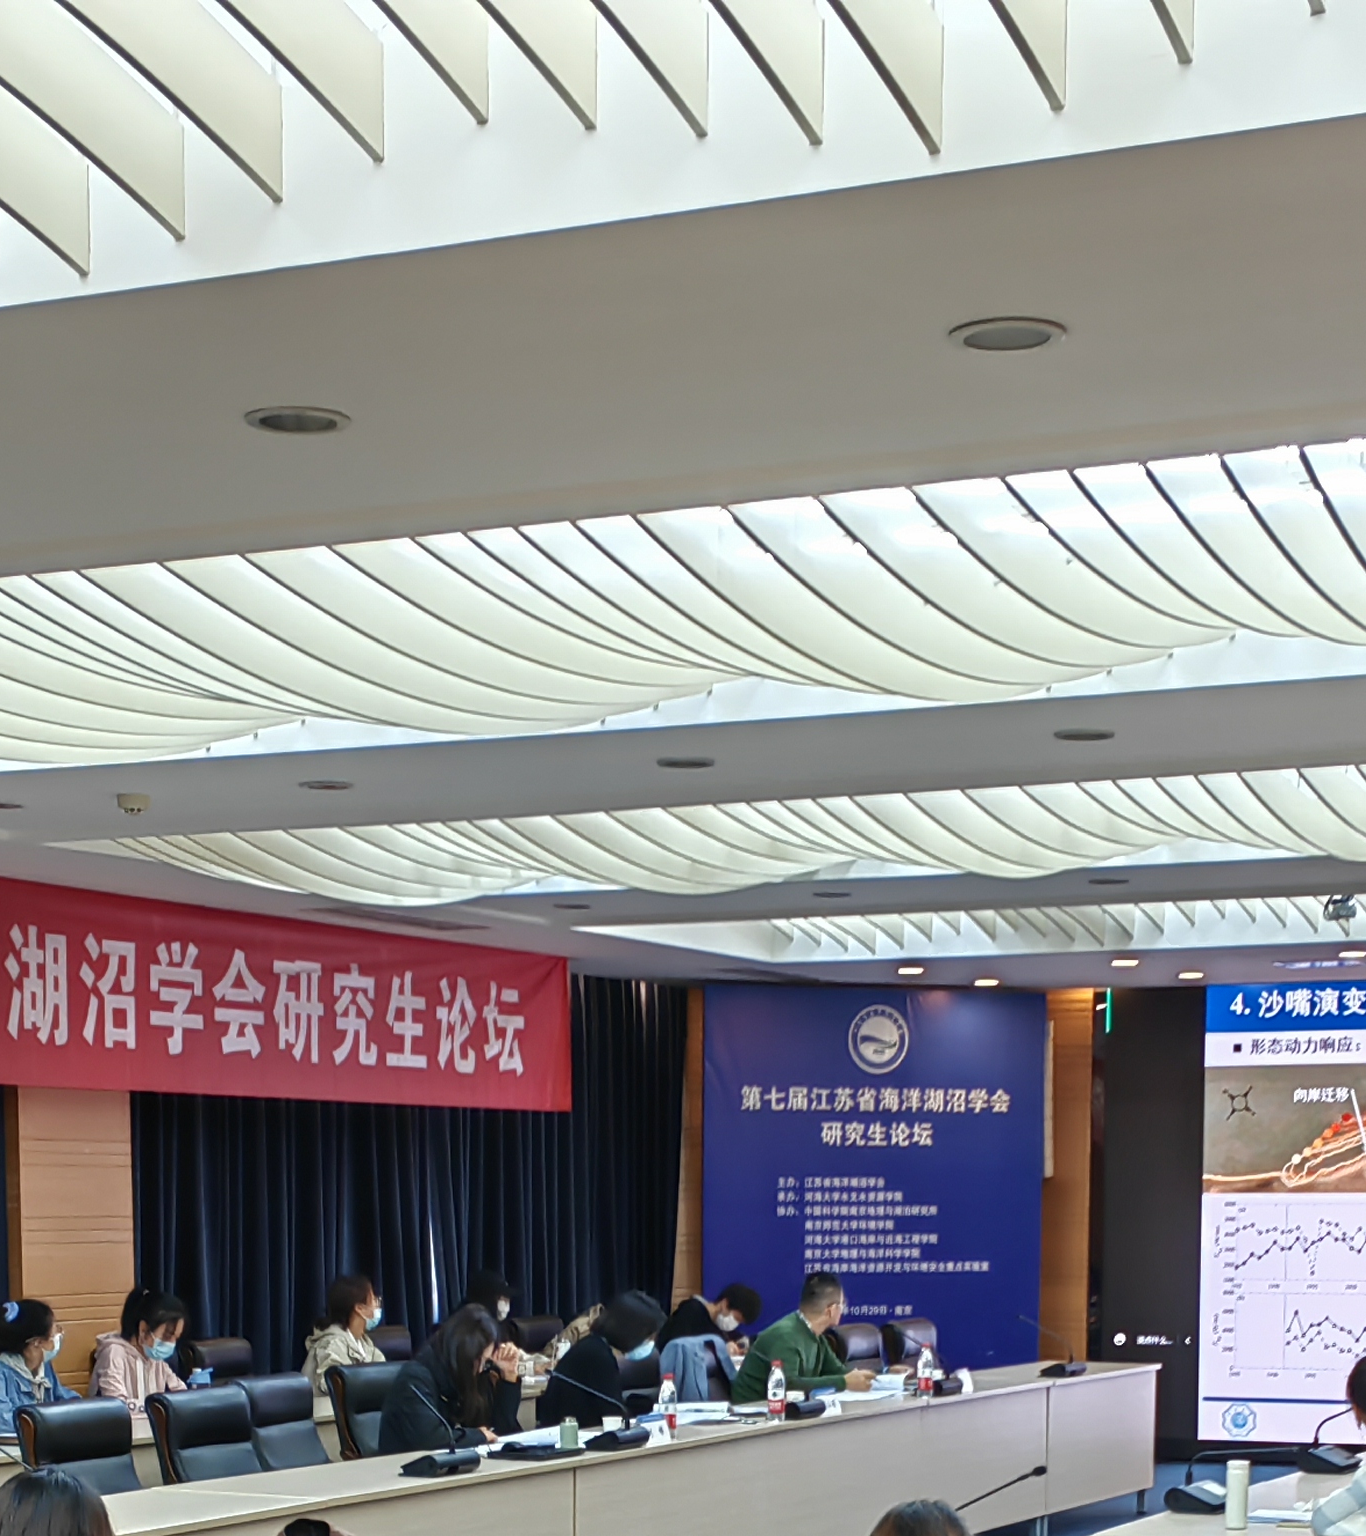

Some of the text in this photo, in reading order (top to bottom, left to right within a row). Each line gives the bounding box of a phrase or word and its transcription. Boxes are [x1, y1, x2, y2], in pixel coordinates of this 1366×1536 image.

[740, 1085, 1011, 1114] 第七届江苏省海洋湖沼学会
[1293, 1087, 1350, 1104] 向岸迁移
[820, 1121, 934, 1147] 研究生论坛
